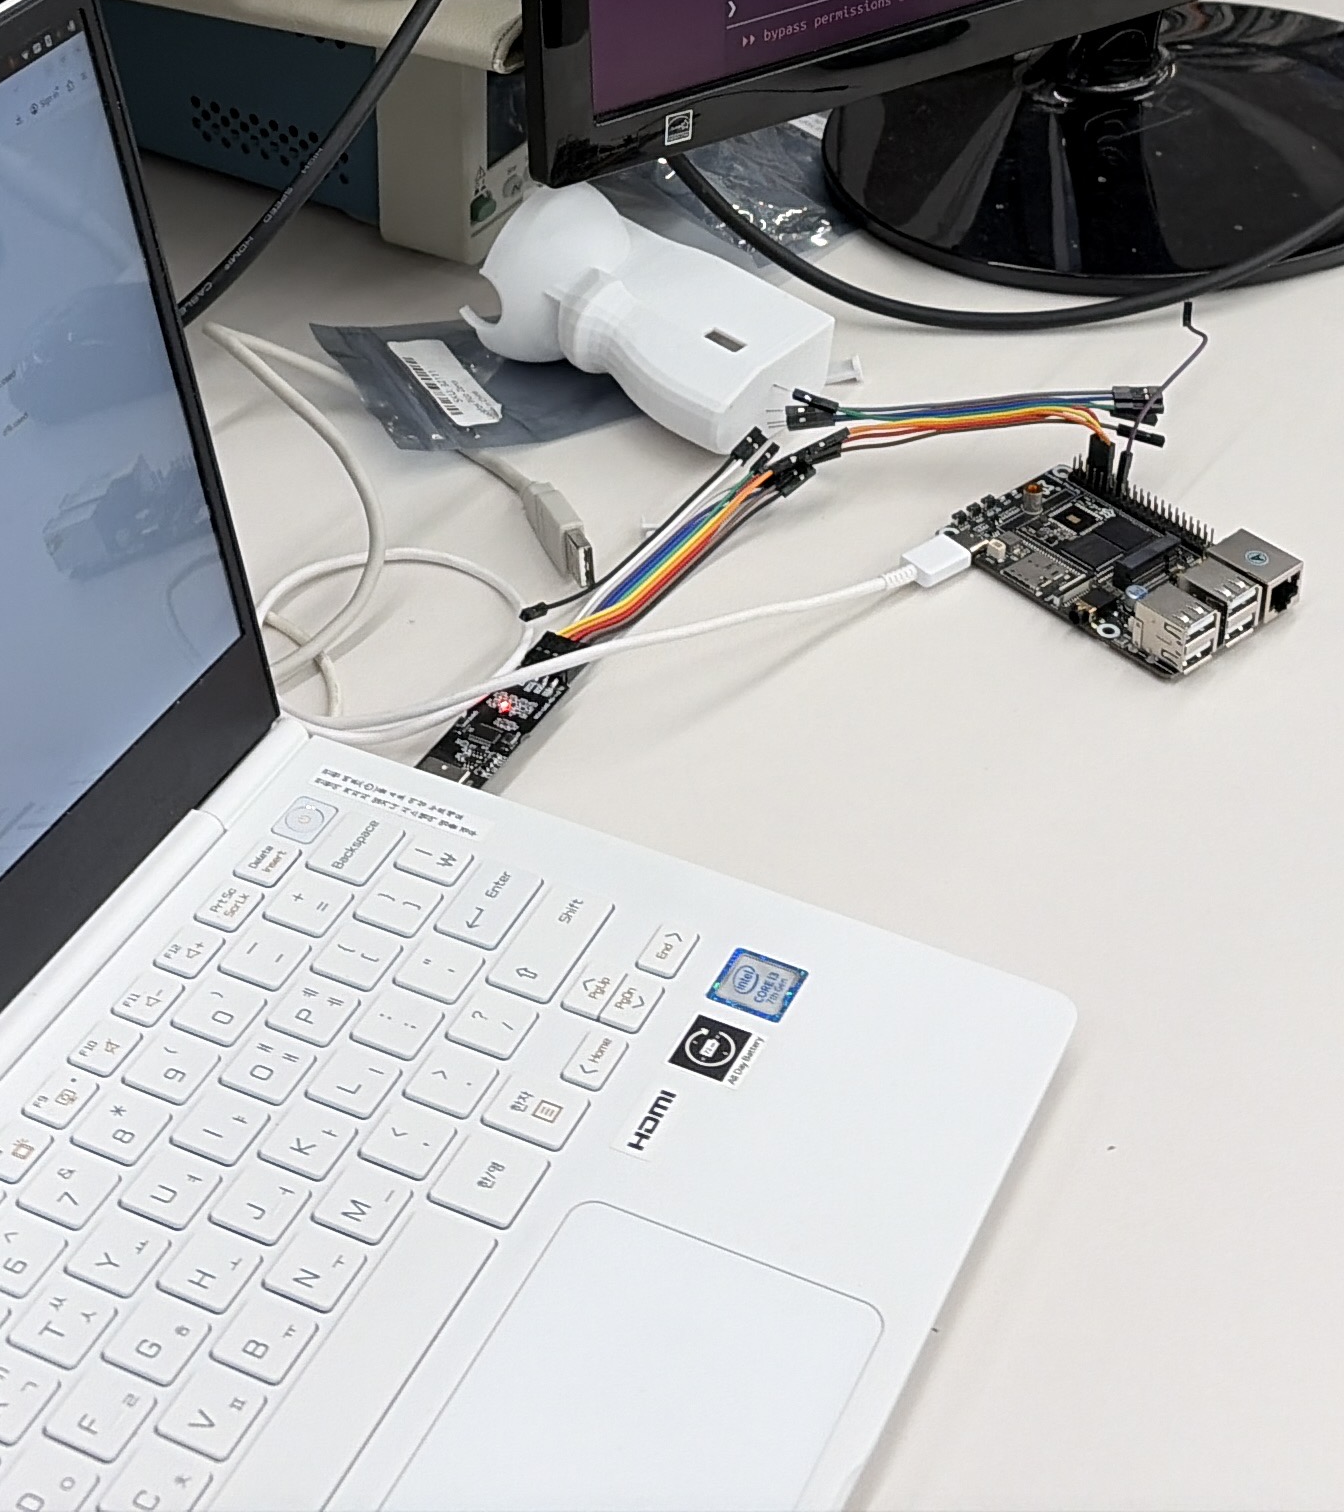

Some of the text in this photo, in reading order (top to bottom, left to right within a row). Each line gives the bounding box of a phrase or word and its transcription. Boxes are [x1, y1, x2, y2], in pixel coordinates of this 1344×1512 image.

[331, 819, 380, 870] Backspace
[485, 869, 513, 899] Enter
[558, 896, 584, 924] Shift
[656, 943, 673, 960] End
[589, 976, 610, 1000] PgUp
[614, 987, 636, 1010] PgDn
[754, 979, 773, 1003] CORE
[589, 1037, 612, 1065] Home
[743, 1036, 765, 1063] Battery
[626, 1089, 677, 1151] HDMI
[290, 1137, 317, 1156] K
[188, 1267, 216, 1289] H
